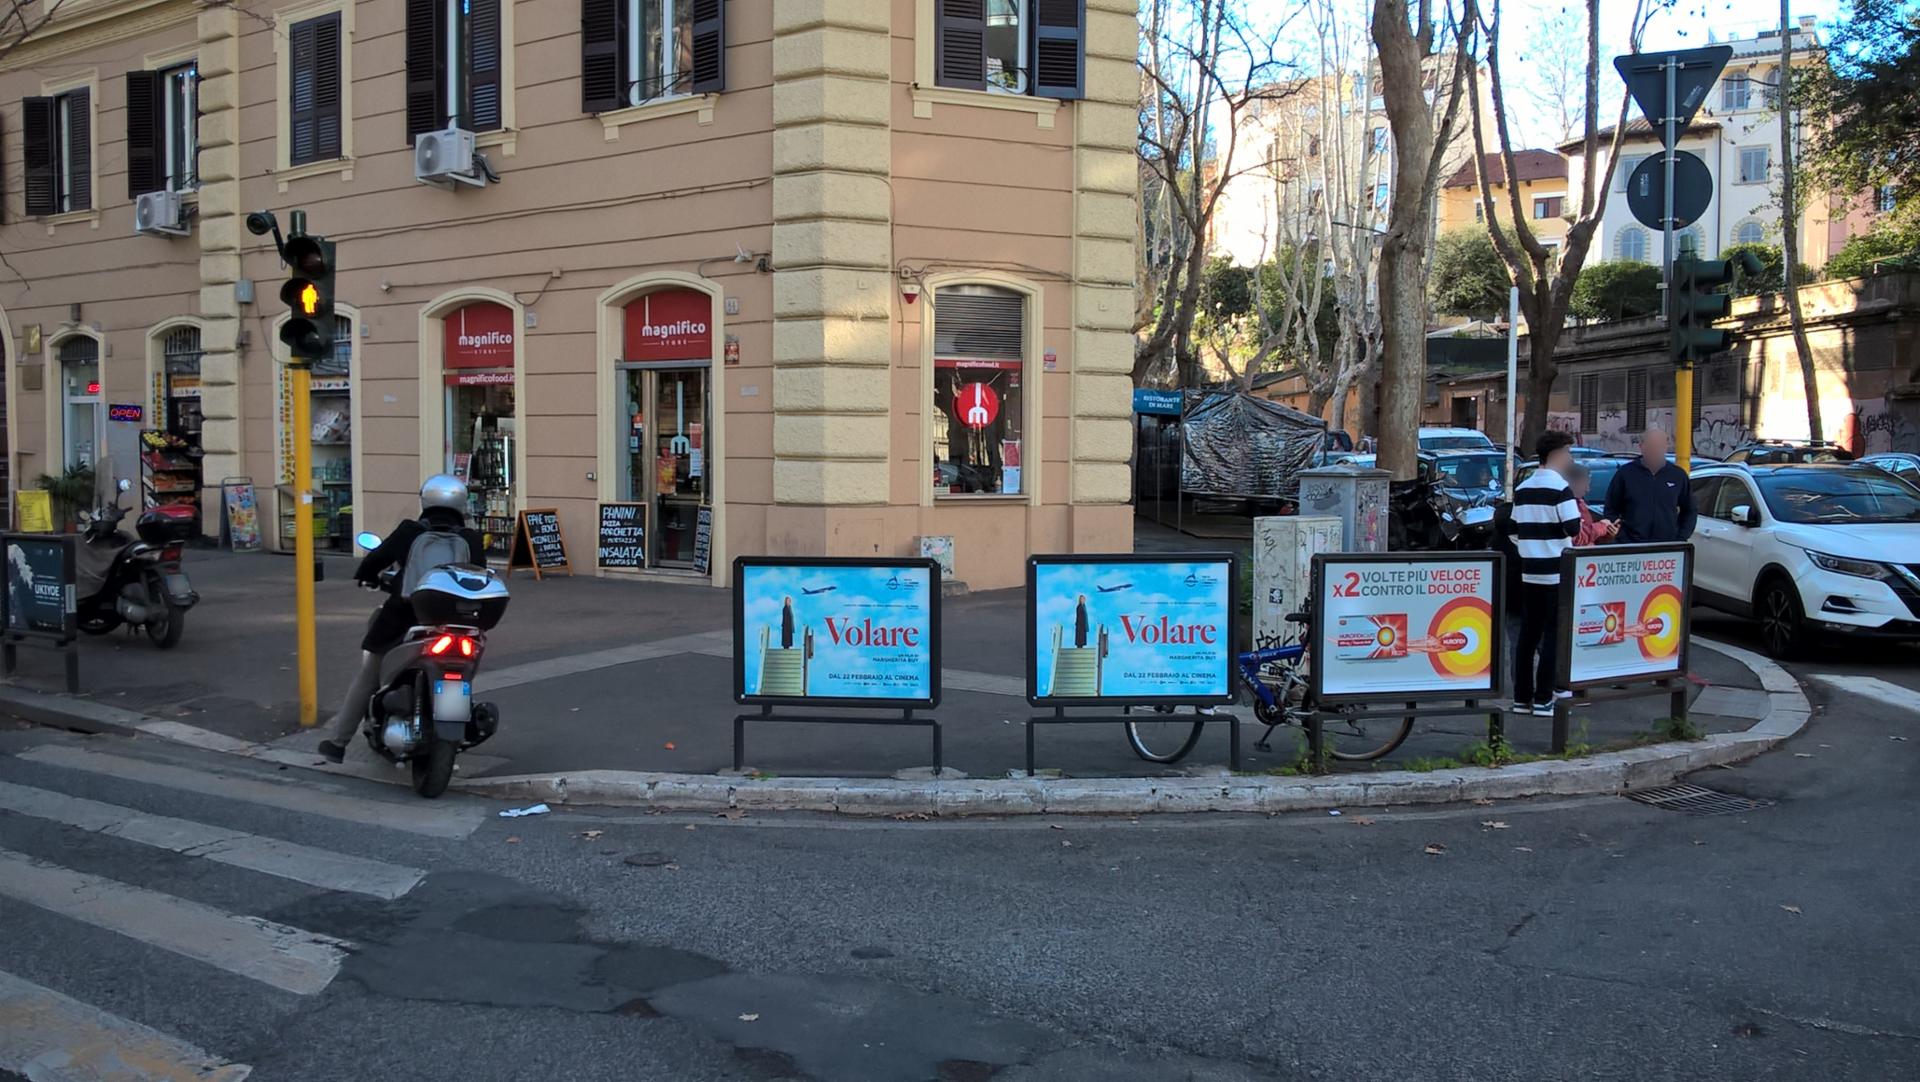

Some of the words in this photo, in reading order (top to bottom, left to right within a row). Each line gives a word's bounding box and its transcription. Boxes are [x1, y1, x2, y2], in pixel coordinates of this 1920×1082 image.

[642, 320, 706, 338] magnifico
[458, 331, 513, 348] magnifico
[1143, 395, 1180, 404] RISTORANTE
[110, 408, 141, 418] OPEN
[602, 506, 637, 520] PANINI
[600, 527, 644, 537] PORCHETTA
[598, 546, 644, 560] INSALATA
[1598, 561, 1627, 574] VOLTE
[1642, 559, 1677, 571] VELOCE
[1361, 570, 1405, 583] VOLTE
[1407, 568, 1428, 582] PIÙ
[1430, 569, 1481, 581] VELOCE
[1597, 574, 1632, 586] CONTRO
[1632, 574, 1639, 584] IL
[1361, 584, 1414, 597] CONTRO
[1416, 584, 1426, 595] IL
[824, 616, 919, 647] Volare
[1120, 615, 1217, 645] Volare
[851, 673, 883, 681] FEBBRAIO
